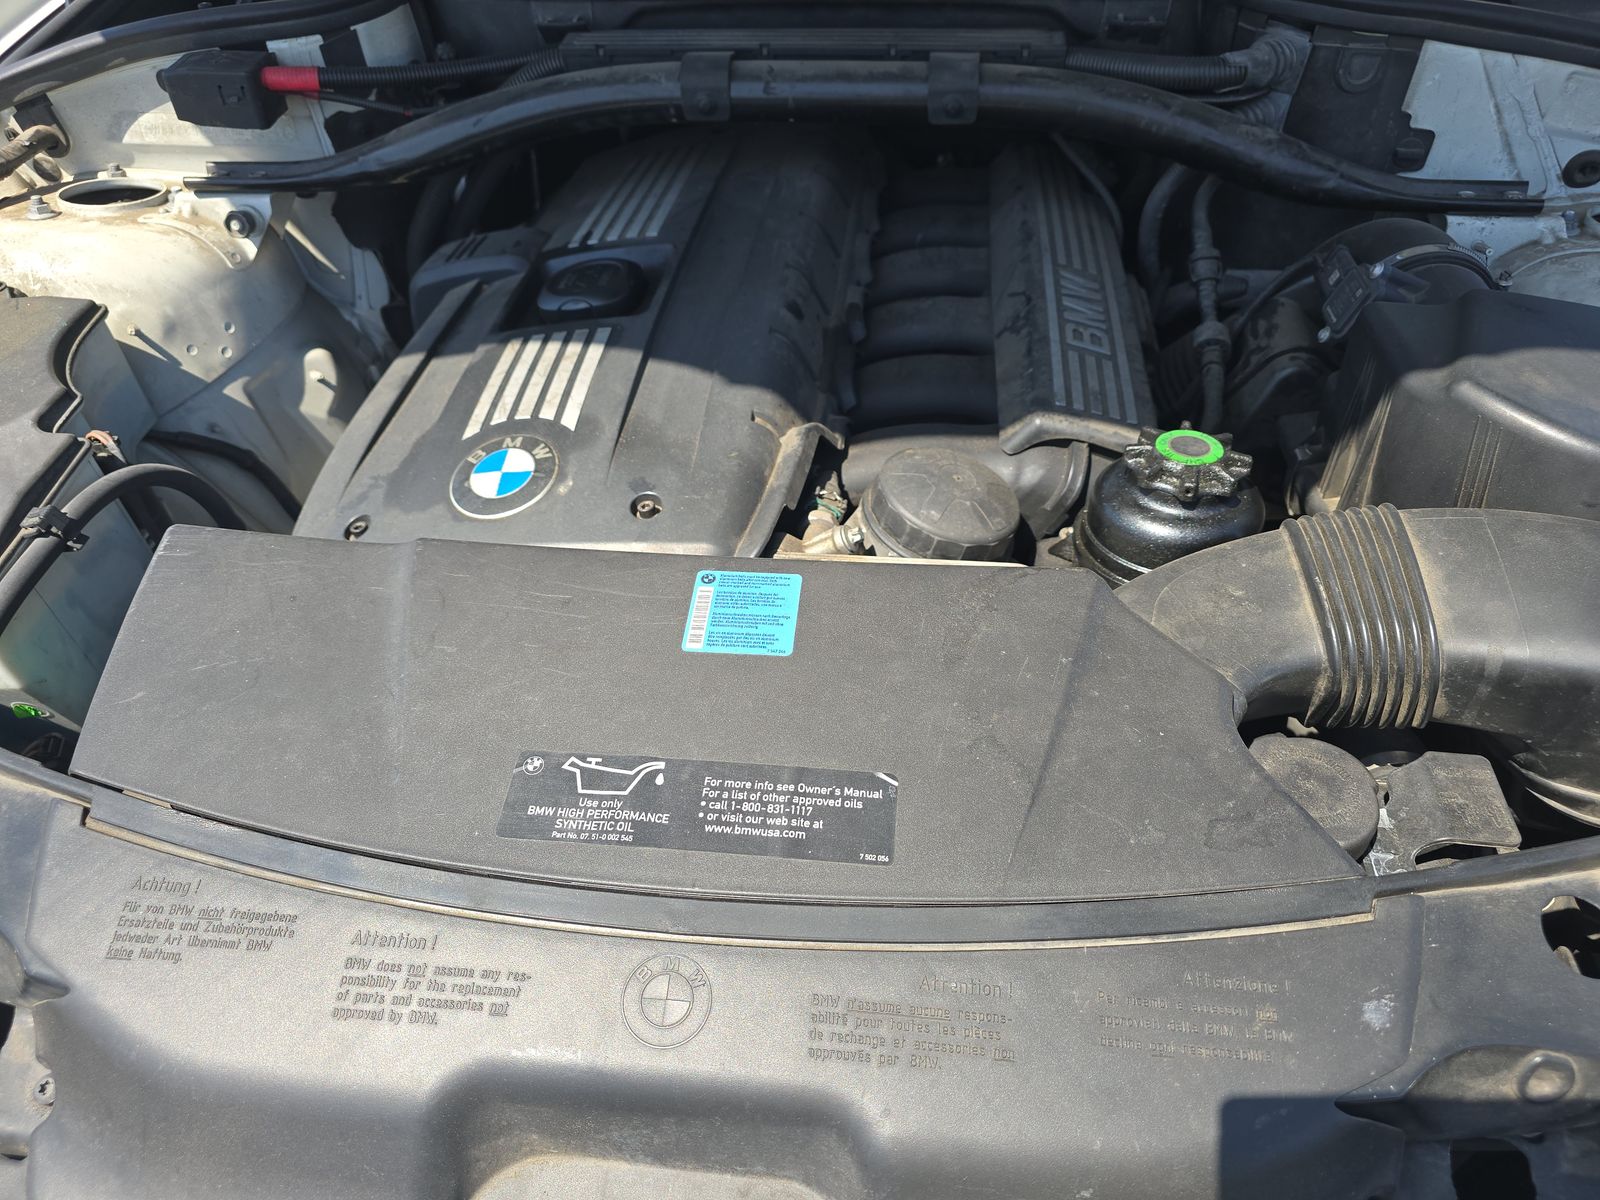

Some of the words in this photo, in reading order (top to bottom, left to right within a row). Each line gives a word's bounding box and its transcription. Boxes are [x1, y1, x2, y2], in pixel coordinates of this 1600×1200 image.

[1059, 270, 1112, 355] BMW
[466, 436, 553, 464] BMW
[702, 788, 721, 798] For
[722, 791, 729, 799] a
[731, 789, 748, 800] list
[751, 792, 761, 801] of
[763, 793, 790, 803] other
[792, 796, 842, 807] approved
[844, 799, 863, 808] oils
[704, 777, 723, 787] For
[724, 780, 752, 789] more
[754, 780, 774, 790] info
[776, 784, 795, 792] see
[844, 787, 883, 799] Manual
[579, 797, 599, 808] Use
[601, 799, 623, 810] only
[709, 801, 728, 810] call
[731, 801, 813, 817] 1-800-831-1117
[527, 806, 555, 816] BMW
[557, 808, 584, 818] HIGH
[586, 809, 670, 824] PERFORMANCE
[555, 819, 615, 831] SYNTHETIC
[617, 822, 634, 832] OIL
[707, 813, 719, 821] or
[721, 813, 743, 823] visit
[745, 816, 764, 824] our
[766, 816, 788, 826] web
[791, 819, 810, 828] site
[813, 820, 823, 829] at
[551, 831, 566, 839] Part
[704, 823, 806, 839] www.bmwusa.com
[131, 876, 192, 897] Achtung
[122, 901, 141, 913] Für
[146, 904, 164, 915] von
[169, 904, 195, 916] BMW
[197, 906, 225, 921] nicht
[230, 908, 298, 924] freigegebene
[117, 916, 175, 930] Ersatzteile
[180, 922, 200, 932] und
[203, 921, 295, 939] Zubehörprodukte
[111, 931, 159, 944] jedweder
[163, 934, 183, 945] Art
[246, 940, 273, 951] BMW
[352, 929, 427, 950] Attention
[106, 945, 134, 960] keine
[344, 957, 371, 971] BMW
[376, 960, 403, 972] does
[407, 963, 428, 977] not
[433, 965, 475, 978] assume
[481, 969, 501, 982] any
[506, 970, 532, 981] res-
[634, 956, 707, 989] BMW
[339, 975, 397, 991] ponsibility
[403, 977, 421, 990] for
[426, 979, 446, 992] the
[450, 982, 522, 998] replacement
[919, 975, 1002, 998] Attention
[1183, 971, 1280, 995] Attenzione
[336, 990, 348, 1001] of
[353, 993, 385, 1005] parts
[390, 994, 413, 1007] and
[417, 997, 484, 1012] accessories
[489, 1001, 510, 1017] not
[811, 993, 841, 1008] BMW
[909, 1004, 951, 1021] aucune
[957, 1009, 1013, 1024] respons-
[332, 1007, 385, 1021] approved
[388, 1010, 403, 1025] by
[408, 1010, 438, 1025] BMW.
[810, 1012, 849, 1026] abilité
[854, 1017, 883, 1029] pour
[890, 1018, 931, 1033] toutes
[938, 1023, 956, 1036] les
[963, 1026, 1001, 1041] pièces
[809, 1028, 824, 1041] de
[830, 1031, 886, 1049] rechange
[893, 1038, 906, 1048] et
[914, 1040, 986, 1057] accessories
[992, 1047, 1016, 1063] non
[808, 1047, 872, 1063] approuvés
[878, 1054, 900, 1067] par
[909, 1055, 942, 1070] BMW.
